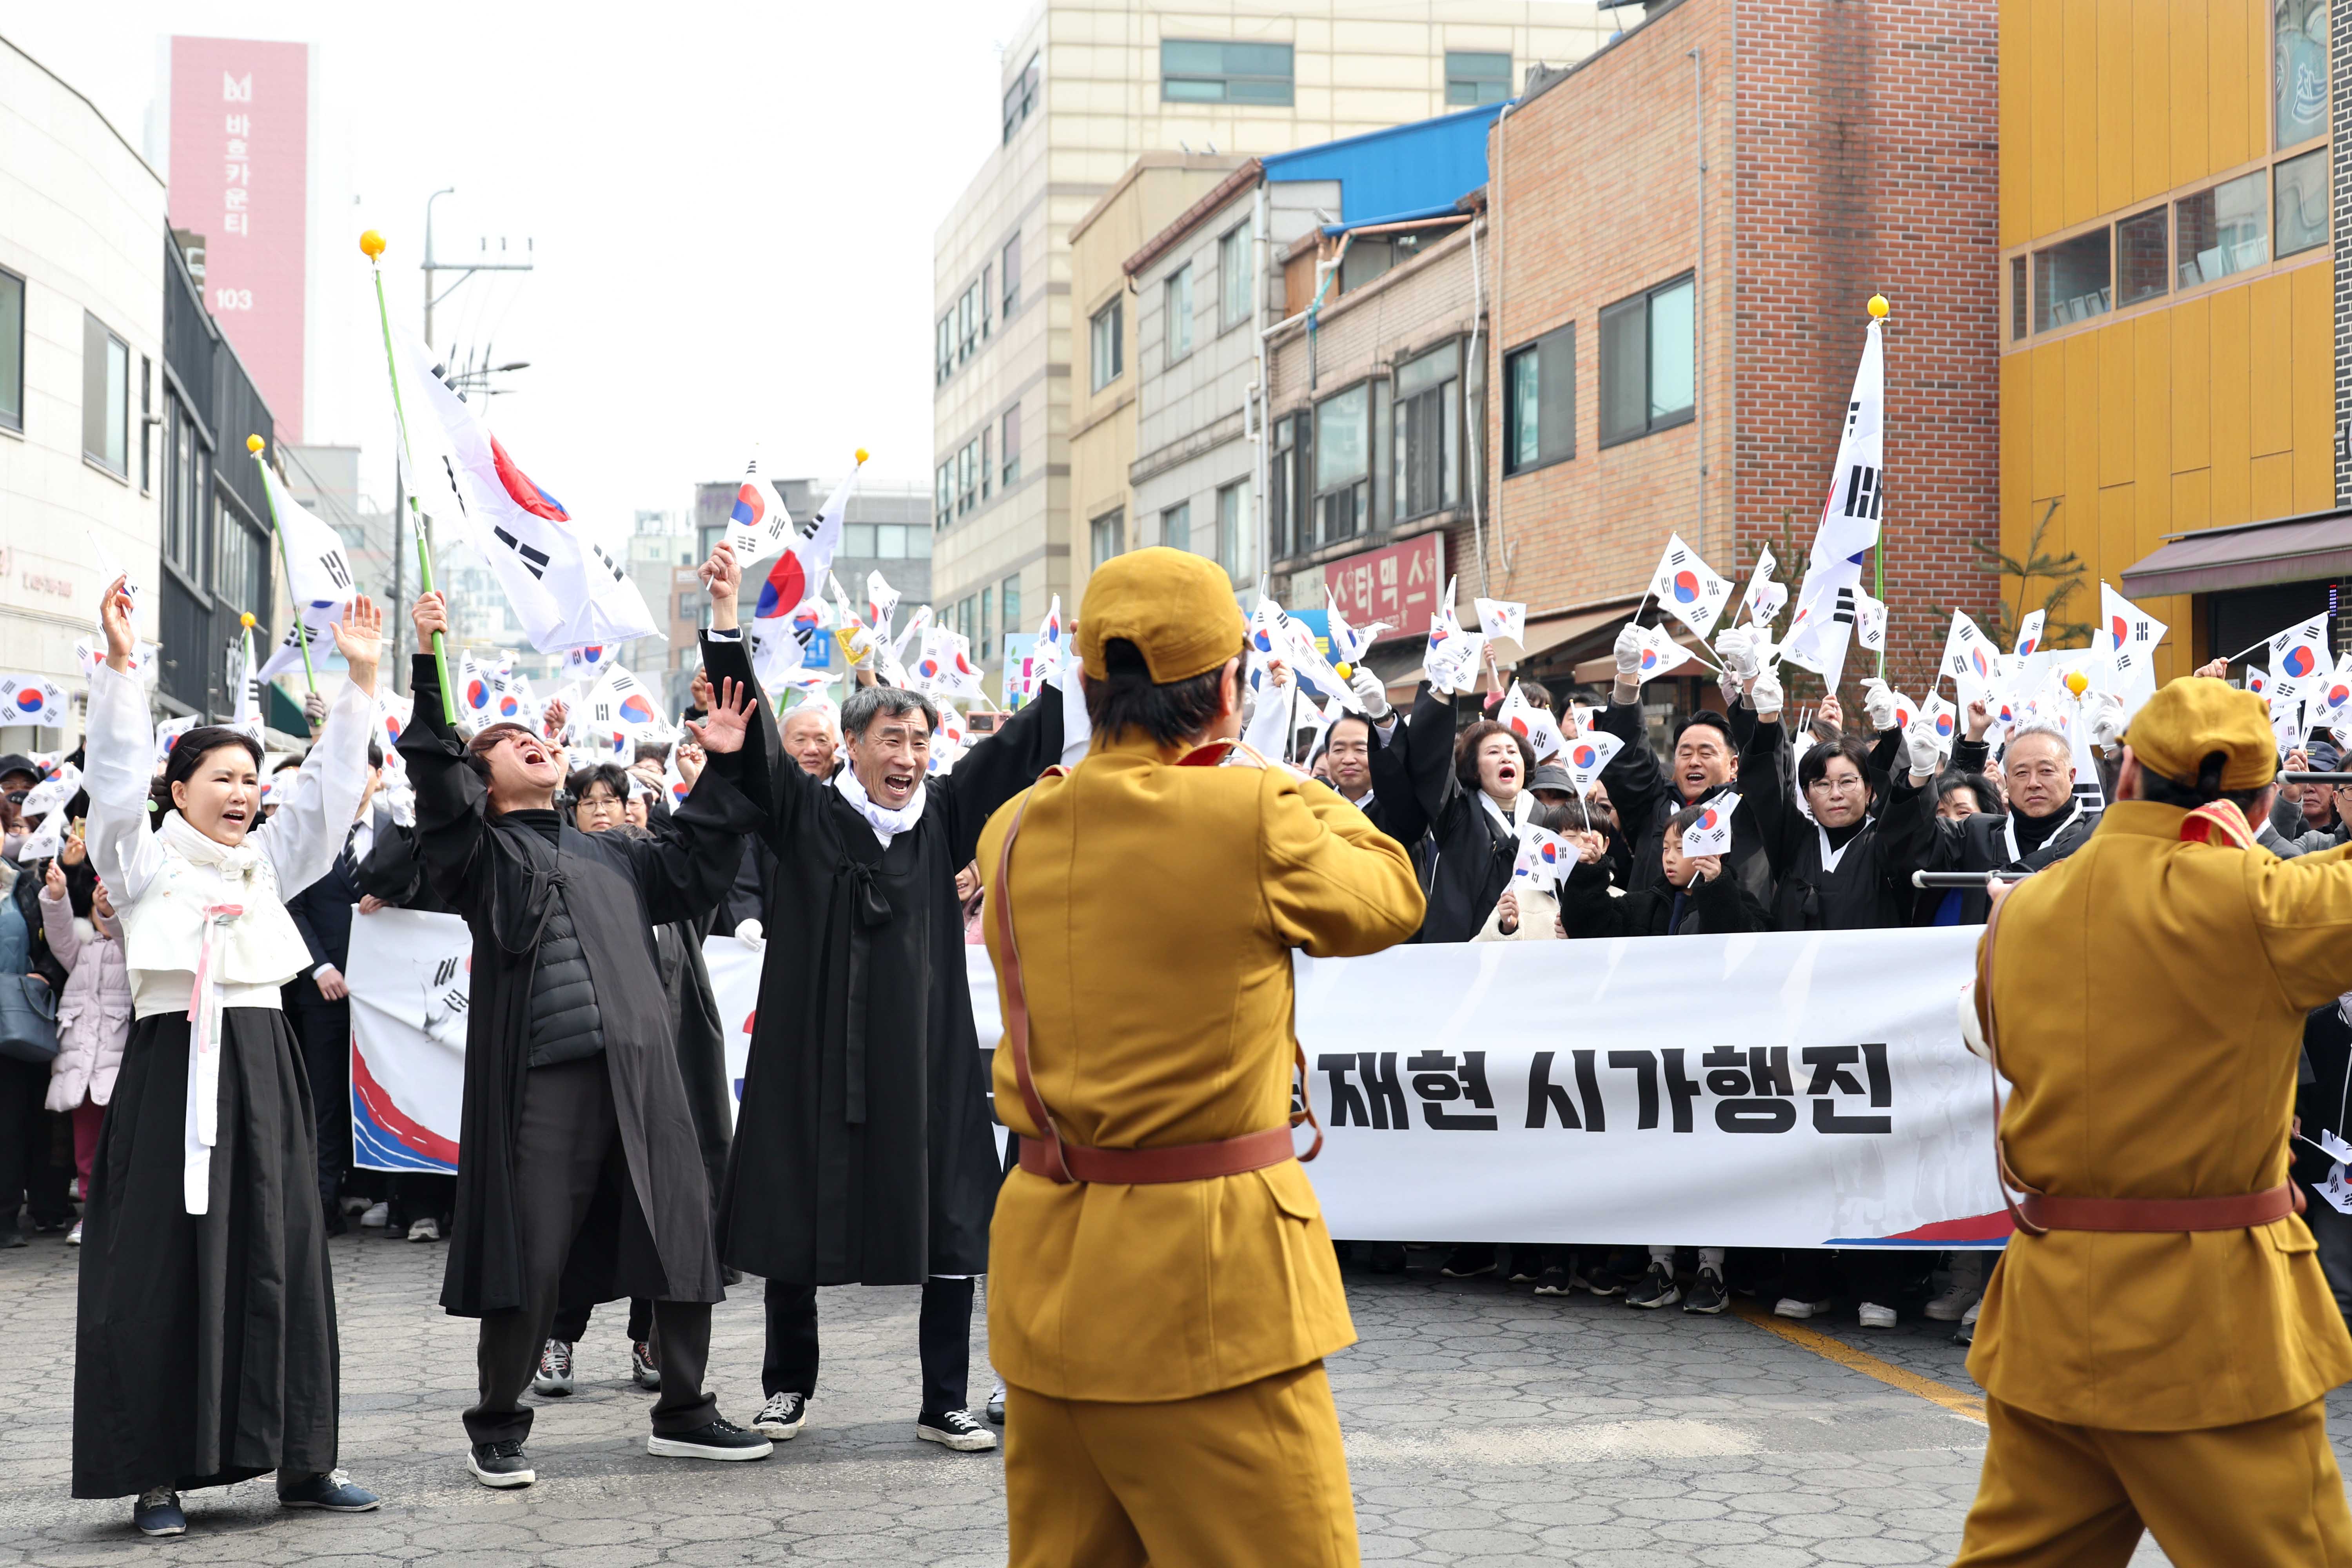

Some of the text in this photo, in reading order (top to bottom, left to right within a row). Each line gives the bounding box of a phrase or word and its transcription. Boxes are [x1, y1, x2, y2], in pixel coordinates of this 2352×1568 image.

[225, 114, 251, 237] 바흐카운티
[216, 288, 253, 310] 103
[1332, 550, 1426, 617] 스타맥스
[1318, 1050, 1498, 1131] 재현
[1525, 1044, 1892, 1134] 시가행진
